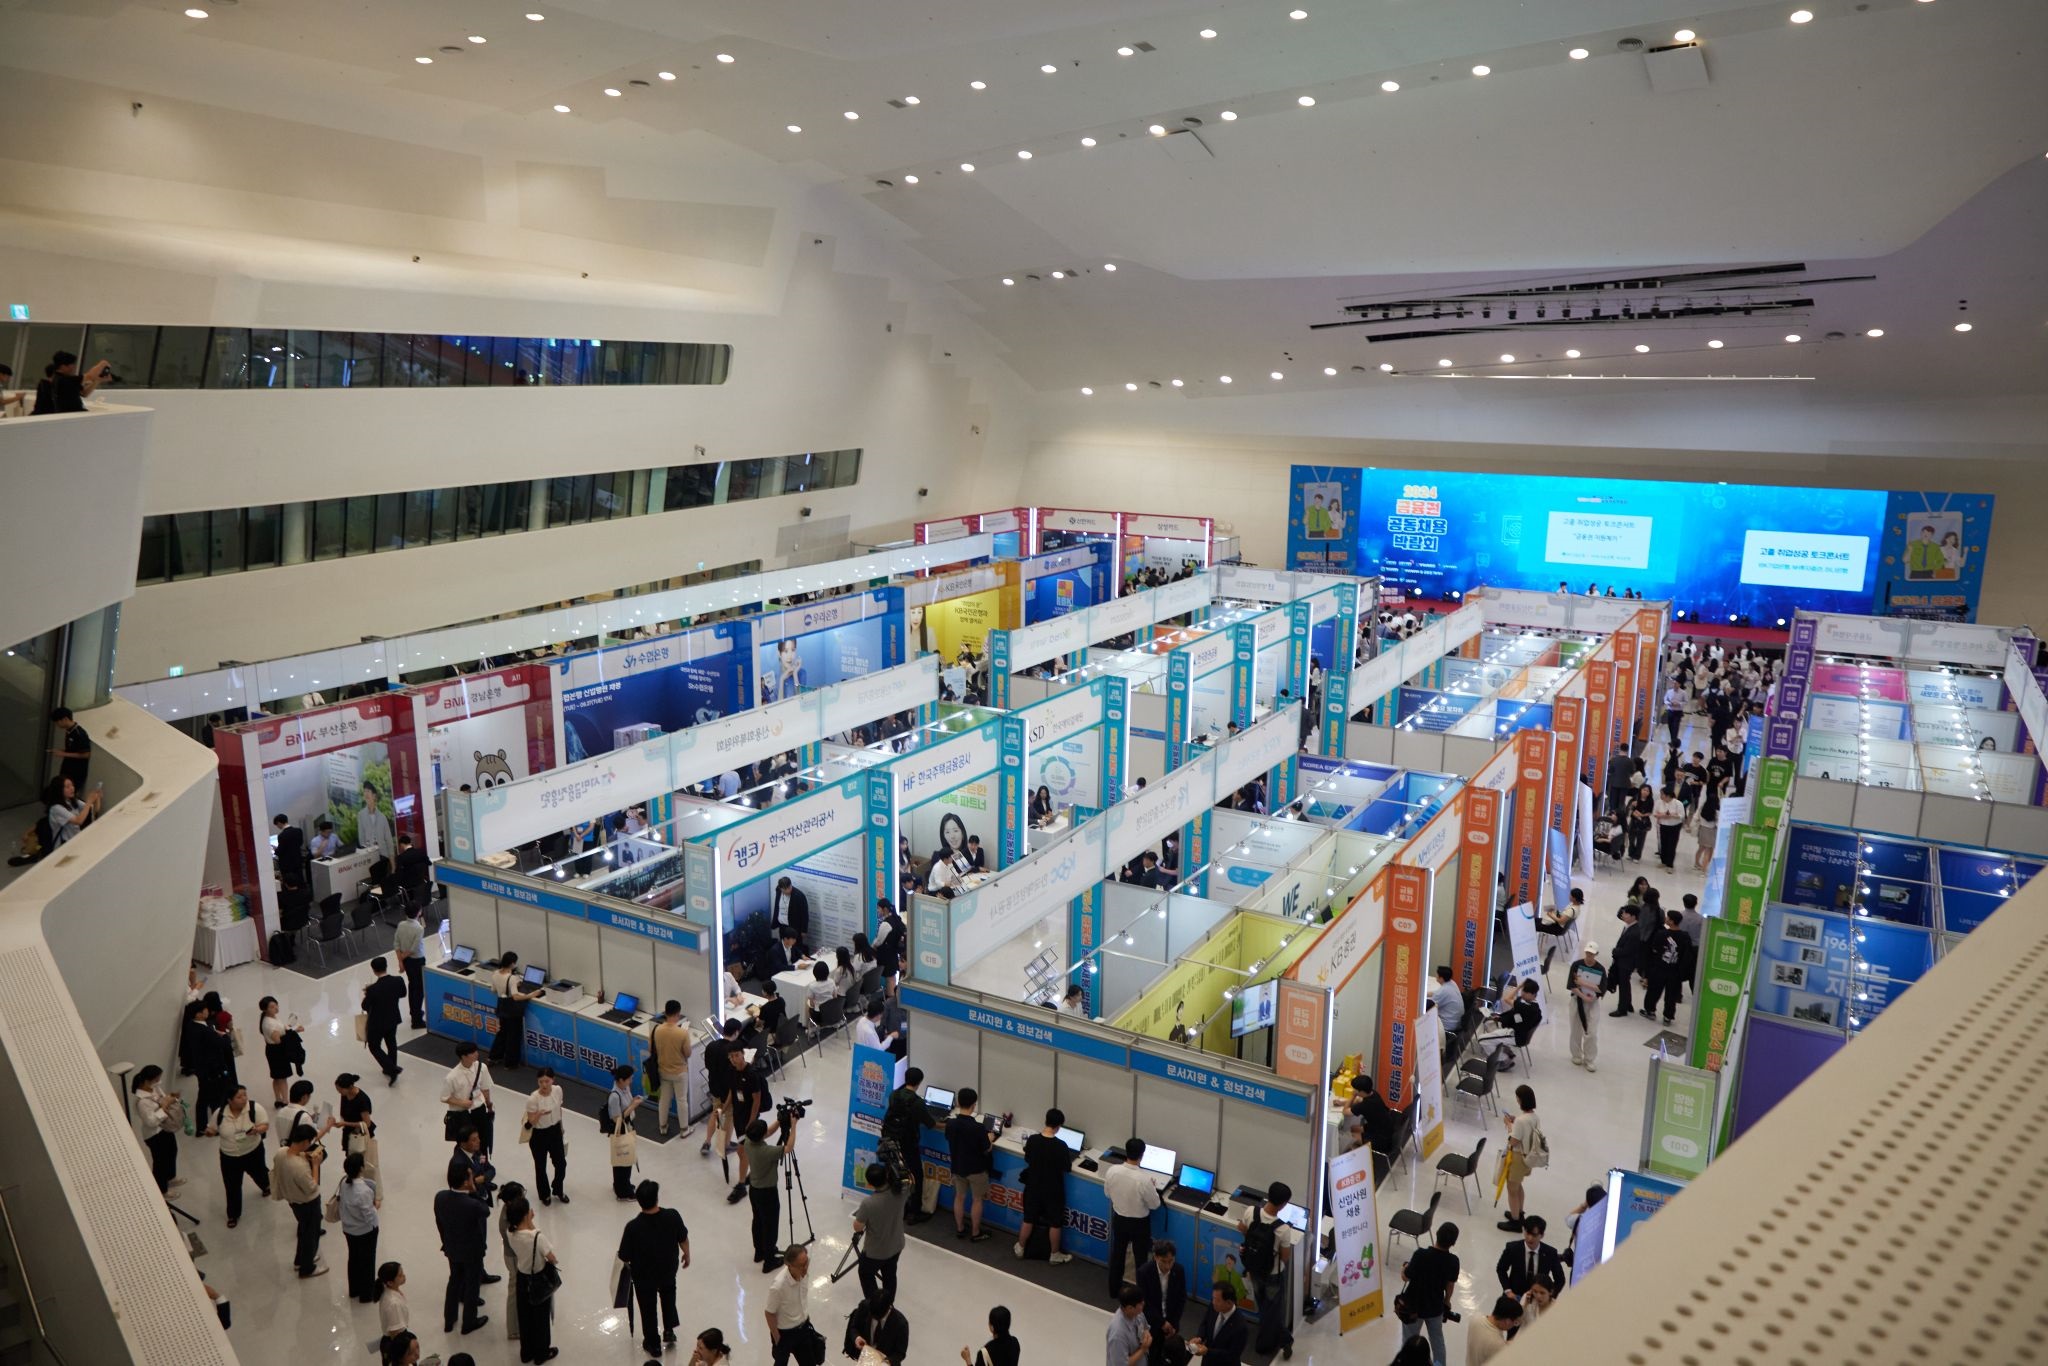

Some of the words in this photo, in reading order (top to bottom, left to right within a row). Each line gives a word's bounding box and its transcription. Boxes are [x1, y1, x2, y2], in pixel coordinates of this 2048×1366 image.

[1396, 499, 1442, 517] 금융권
[1388, 516, 1448, 535] 공동채용
[1393, 534, 1439, 552] 박람회
[1760, 548, 1775, 556] 고졸
[1778, 549, 1809, 558] 취업성공
[1811, 551, 1850, 560] 토크콘서트
[812, 608, 838, 625] 우리은행
[623, 655, 637, 669] Sh
[638, 647, 670, 664] 수협은행
[511, 674, 521, 682] A11
[470, 687, 502, 703] 경남은행
[368, 704, 382, 714] A12
[285, 729, 318, 747] BNK
[318, 719, 358, 738] 부산은행
[1029, 725, 1044, 743] SD
[903, 778, 916, 792] HF
[918, 752, 971, 786] 한국주택금융공사
[1302, 761, 1324, 770] KOREA
[960, 795, 987, 811] 파트너
[733, 840, 759, 868] 캠코
[768, 808, 835, 848] 한국자산관리공사
[1469, 853, 1482, 887] 2024
[1520, 847, 1531, 879] 공동채용
[481, 880, 505, 895] 문서지원
[506, 887, 512, 896] &
[513, 890, 538, 903] 정보검색
[1399, 884, 1413, 894] 금융
[1399, 894, 1413, 904] 투자
[611, 913, 637, 929] 문서지원
[639, 922, 645, 931] &
[647, 924, 674, 941] 정보검색
[1398, 921, 1412, 929] C07
[1464, 920, 1477, 959] 공동채용
[1331, 930, 1357, 974] KB증권
[1721, 943, 1739, 955] 생명
[1395, 944, 1410, 983] 2024
[1720, 953, 1738, 965] 보험
[1717, 982, 1733, 993] D01
[443, 1003, 483, 1029] 2024
[968, 1009, 1003, 1030] 문서지원
[1006, 1020, 1014, 1031] &
[1017, 1023, 1053, 1042] 정보검색
[1708, 1007, 1727, 1050] 2024
[526, 1029, 577, 1060] 공동채용
[578, 1046, 619, 1074] 박람회
[1391, 1022, 1405, 1069] 공동채용
[859, 1078, 886, 1093] 공동채용
[1166, 1064, 1207, 1085] 문서지원
[1211, 1077, 1220, 1089] &
[1223, 1079, 1266, 1102] 정보검색
[1389, 1070, 1402, 1103] 박람회
[861, 1088, 882, 1101] 박람회
[1341, 1174, 1361, 1188] KB증권
[1338, 1188, 1367, 1209] 신입사원
[1345, 1207, 1360, 1218] 채용
[1341, 1222, 1369, 1239] 환영합니다
